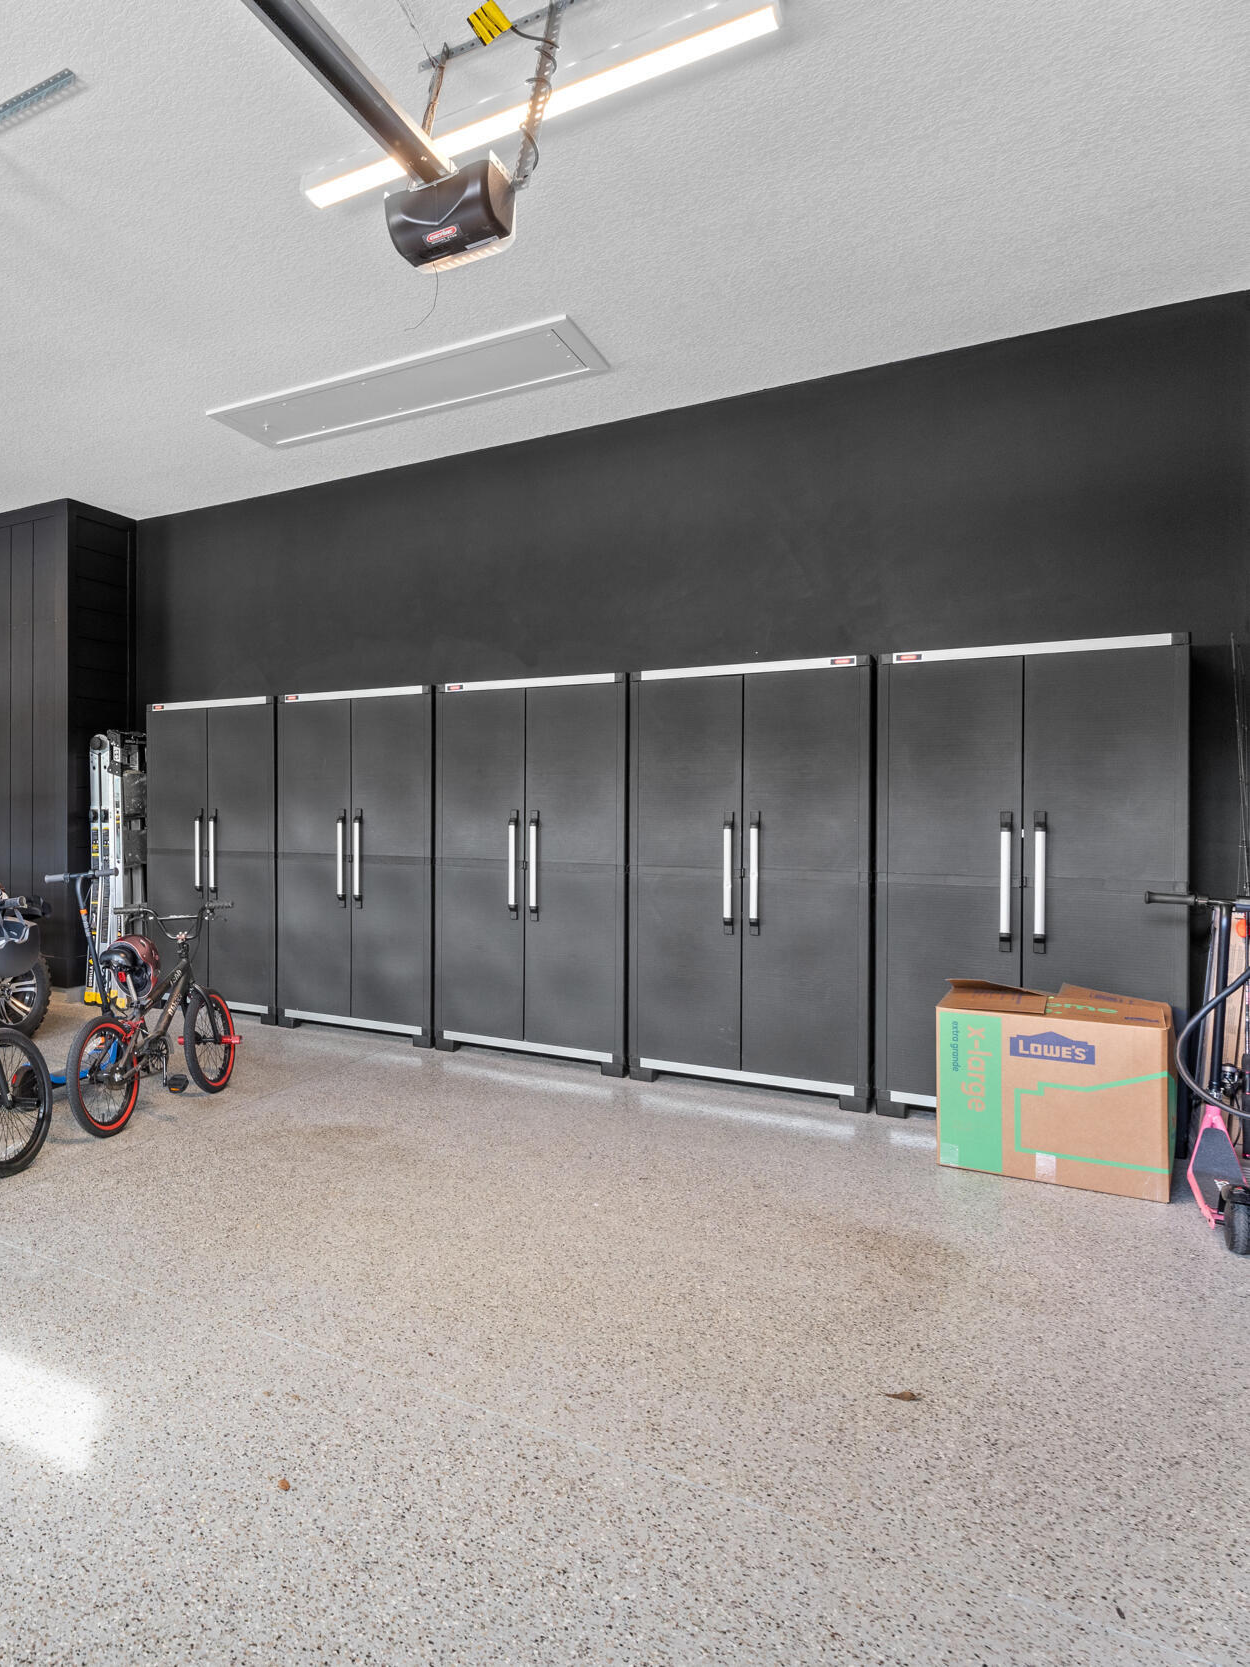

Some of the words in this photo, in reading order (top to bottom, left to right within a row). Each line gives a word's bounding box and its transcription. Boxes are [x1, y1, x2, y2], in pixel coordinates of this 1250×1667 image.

[950, 1043, 962, 1072] grande
[1018, 1039, 1087, 1061] LOWE'S
[960, 1024, 993, 1112] x-large
